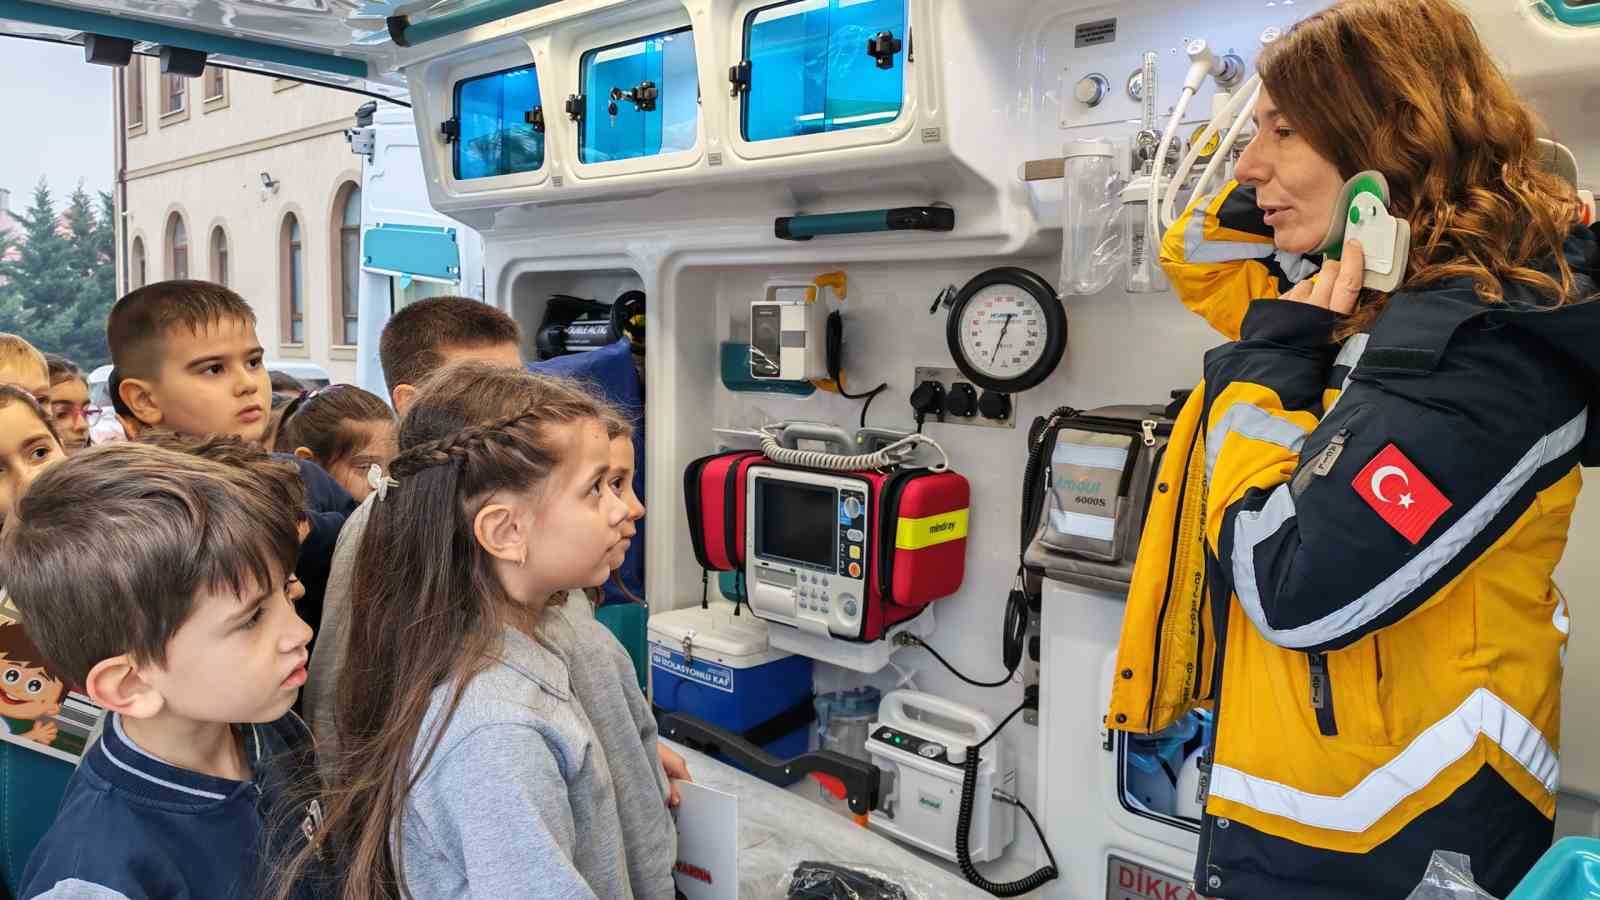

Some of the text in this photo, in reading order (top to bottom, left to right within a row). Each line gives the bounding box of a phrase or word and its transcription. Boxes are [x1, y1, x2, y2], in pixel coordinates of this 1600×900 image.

[1074, 495, 1106, 507] 6000S
[929, 520, 955, 533] mindray
[1119, 864, 1218, 900] DİKKA
